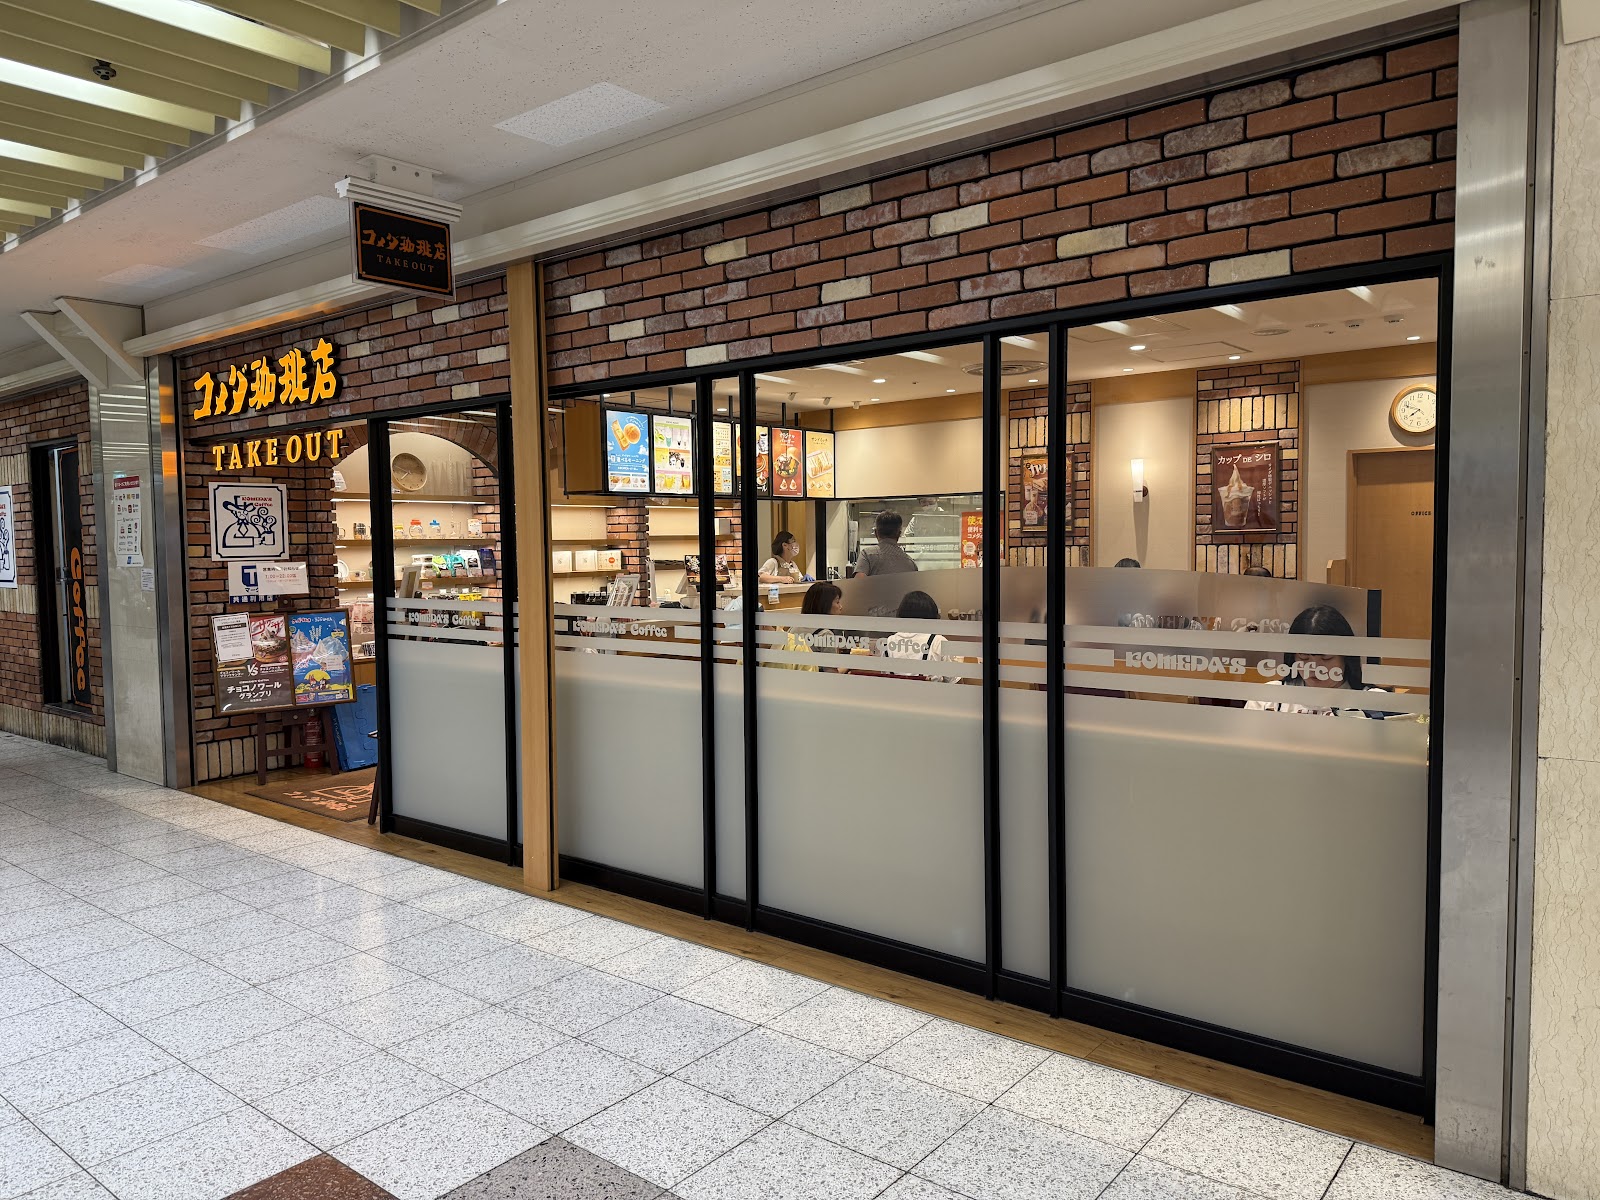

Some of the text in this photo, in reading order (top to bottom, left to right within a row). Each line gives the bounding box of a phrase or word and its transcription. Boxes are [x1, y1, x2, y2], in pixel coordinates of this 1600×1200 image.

[361, 229, 446, 260] コメダ珈琲店
[193, 338, 337, 421] コメダ珈琲店
[213, 429, 343, 471] TAKE OUT
[1218, 454, 1242, 464] カップ
[1254, 453, 1272, 462] シロ
[70, 547, 86, 691] Coffee
[408, 612, 480, 626] KOMEDA'S Coffee
[572, 620, 668, 638] KOMEDA'S Coffee
[795, 632, 930, 654] KOMEDA'S Coffee
[1125, 651, 1344, 682] KOMEDA'S Coffee
[226, 682, 282, 694] チョコノワール
[239, 690, 272, 700] グランプリ
